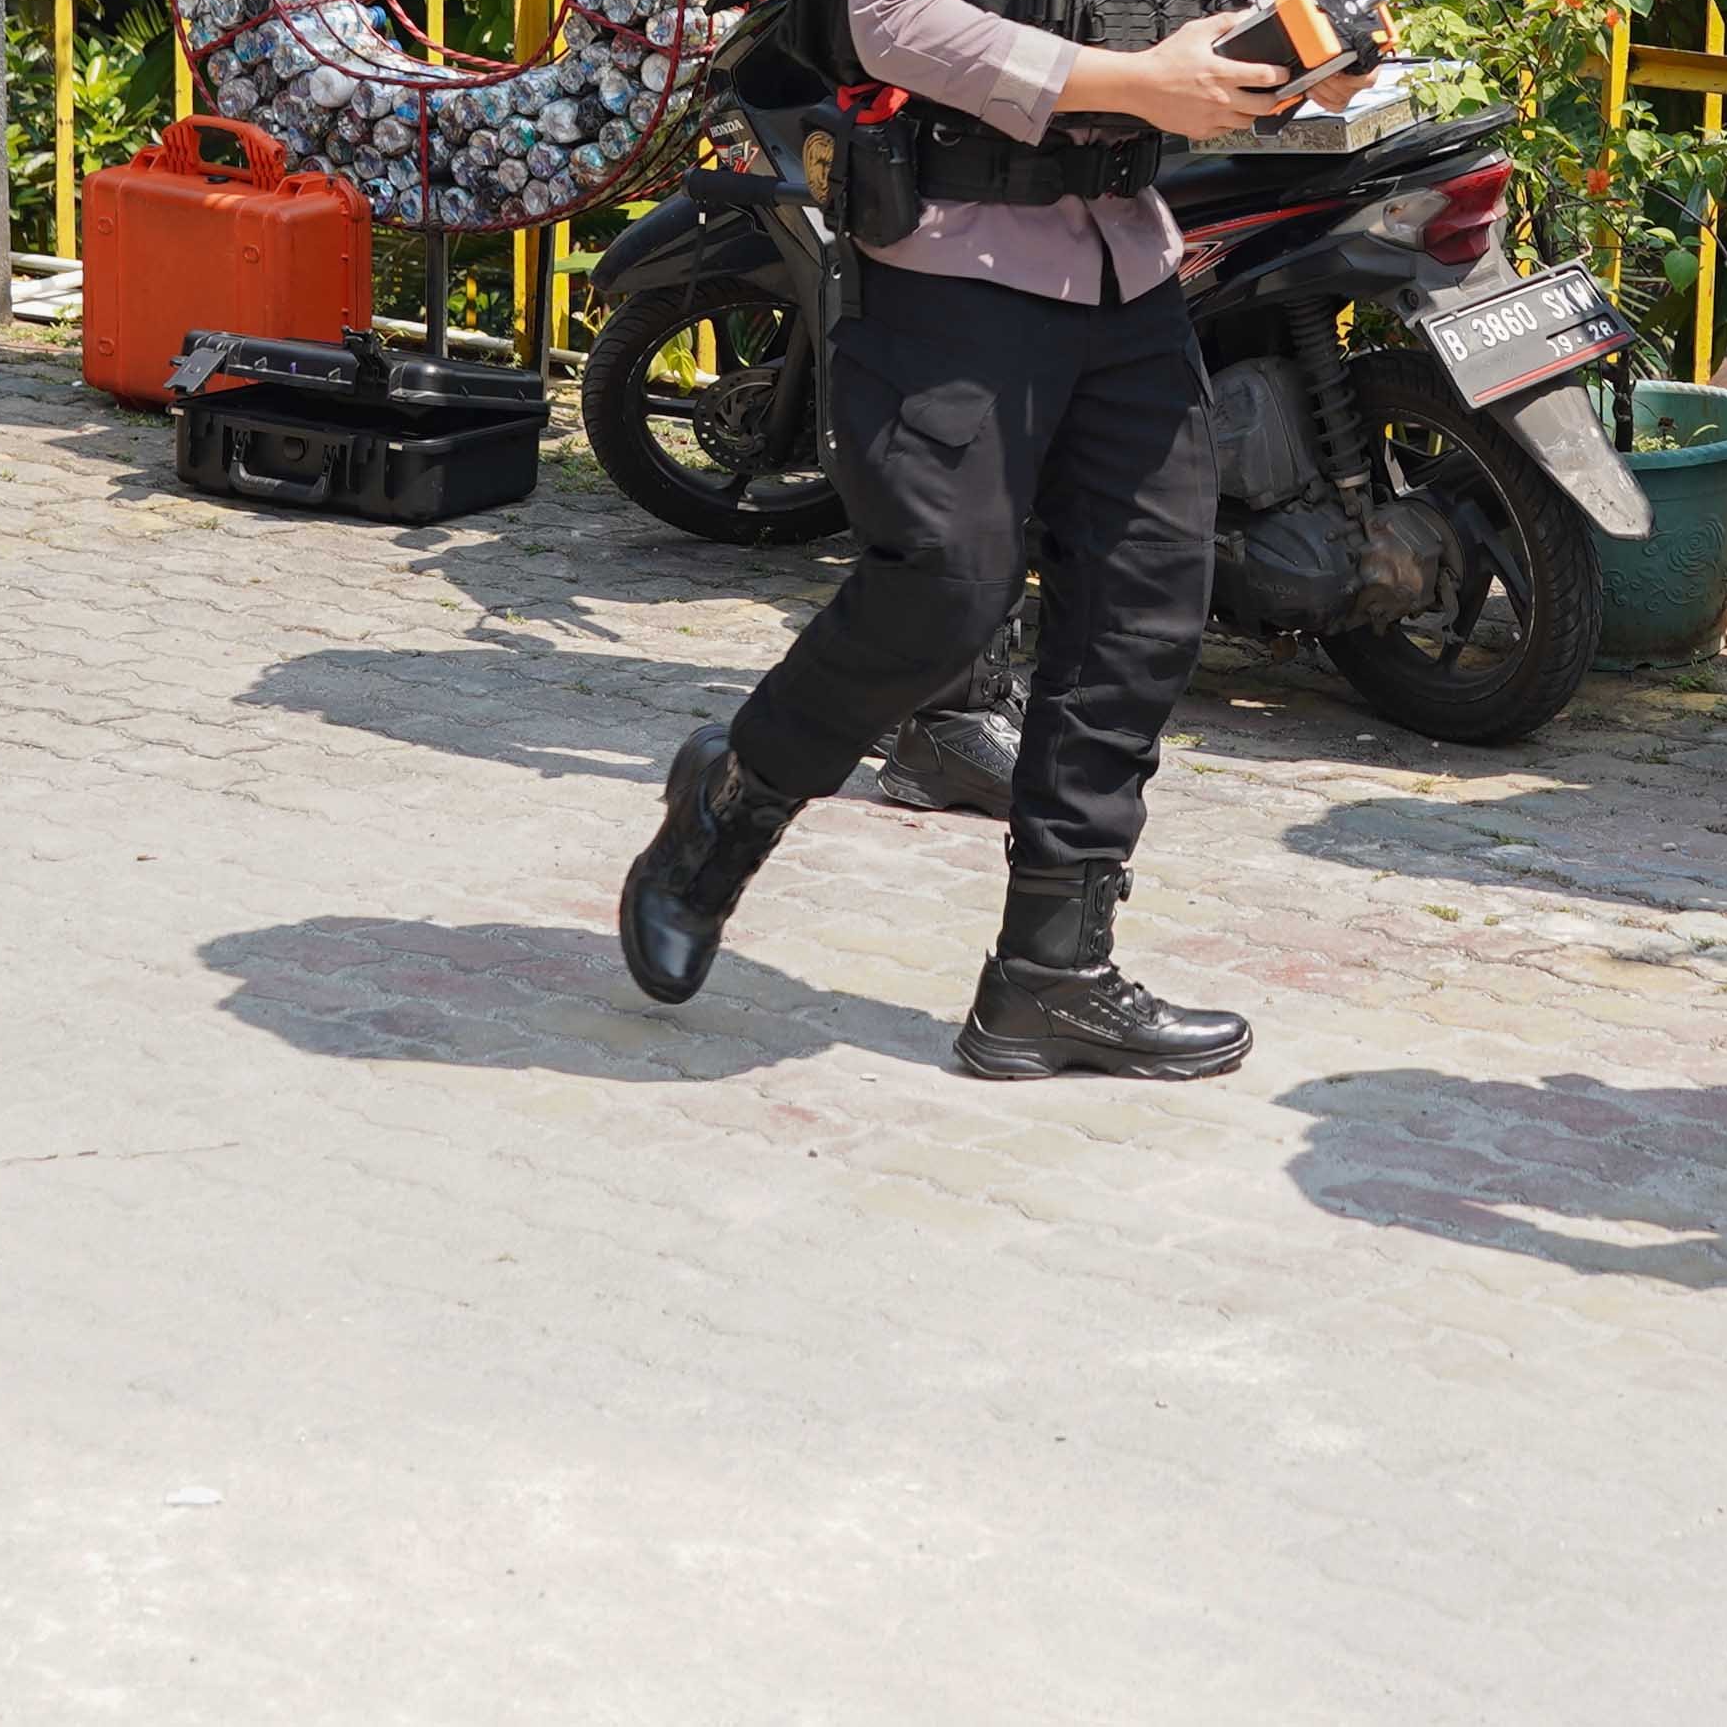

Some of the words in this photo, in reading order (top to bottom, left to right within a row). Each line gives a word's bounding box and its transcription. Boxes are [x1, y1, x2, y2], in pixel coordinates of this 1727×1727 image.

[709, 119, 744, 139] HONDA
[1441, 329, 1468, 362] B
[1471, 301, 1538, 348] 3860
[1541, 280, 1595, 320] SKW
